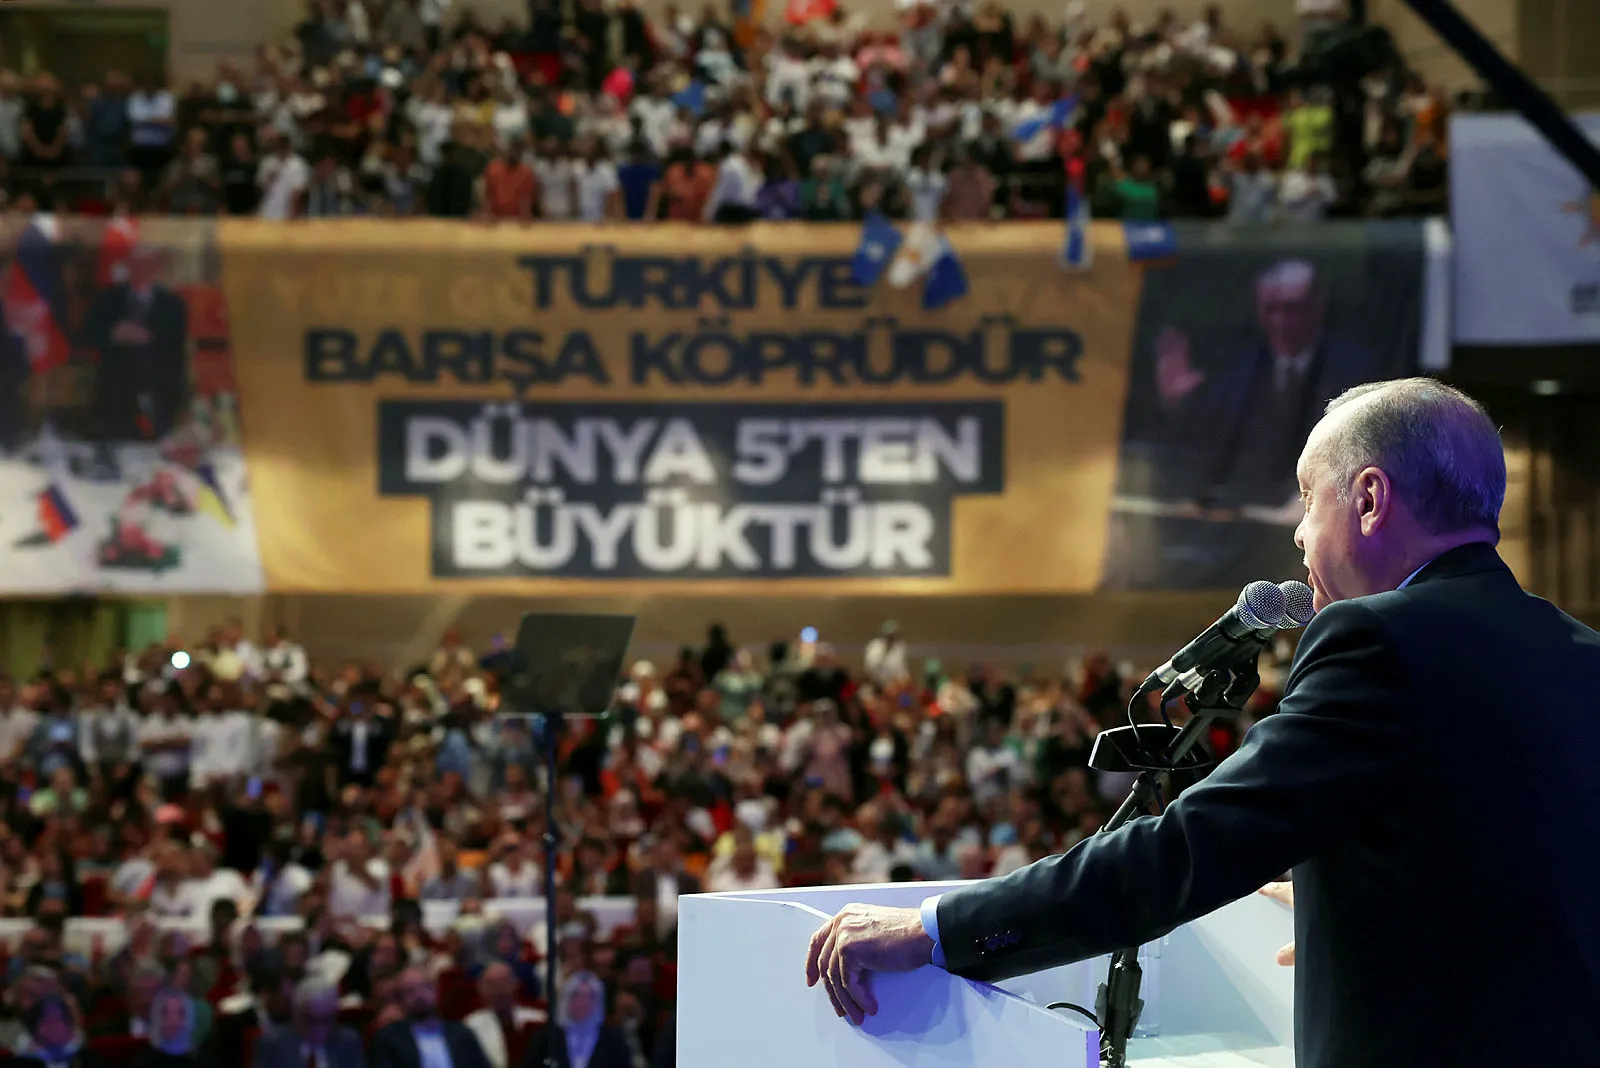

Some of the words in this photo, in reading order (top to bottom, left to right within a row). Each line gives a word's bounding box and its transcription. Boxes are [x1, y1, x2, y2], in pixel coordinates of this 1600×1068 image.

[518, 245, 869, 310] TÜRKİYE
[304, 328, 610, 398] BARIŞA
[628, 314, 1085, 386] KÖPRÜDÜR
[404, 403, 716, 484] DÜNYA
[732, 416, 982, 484] 5'TEN
[450, 486, 935, 571] BÜYÜKTÜR
